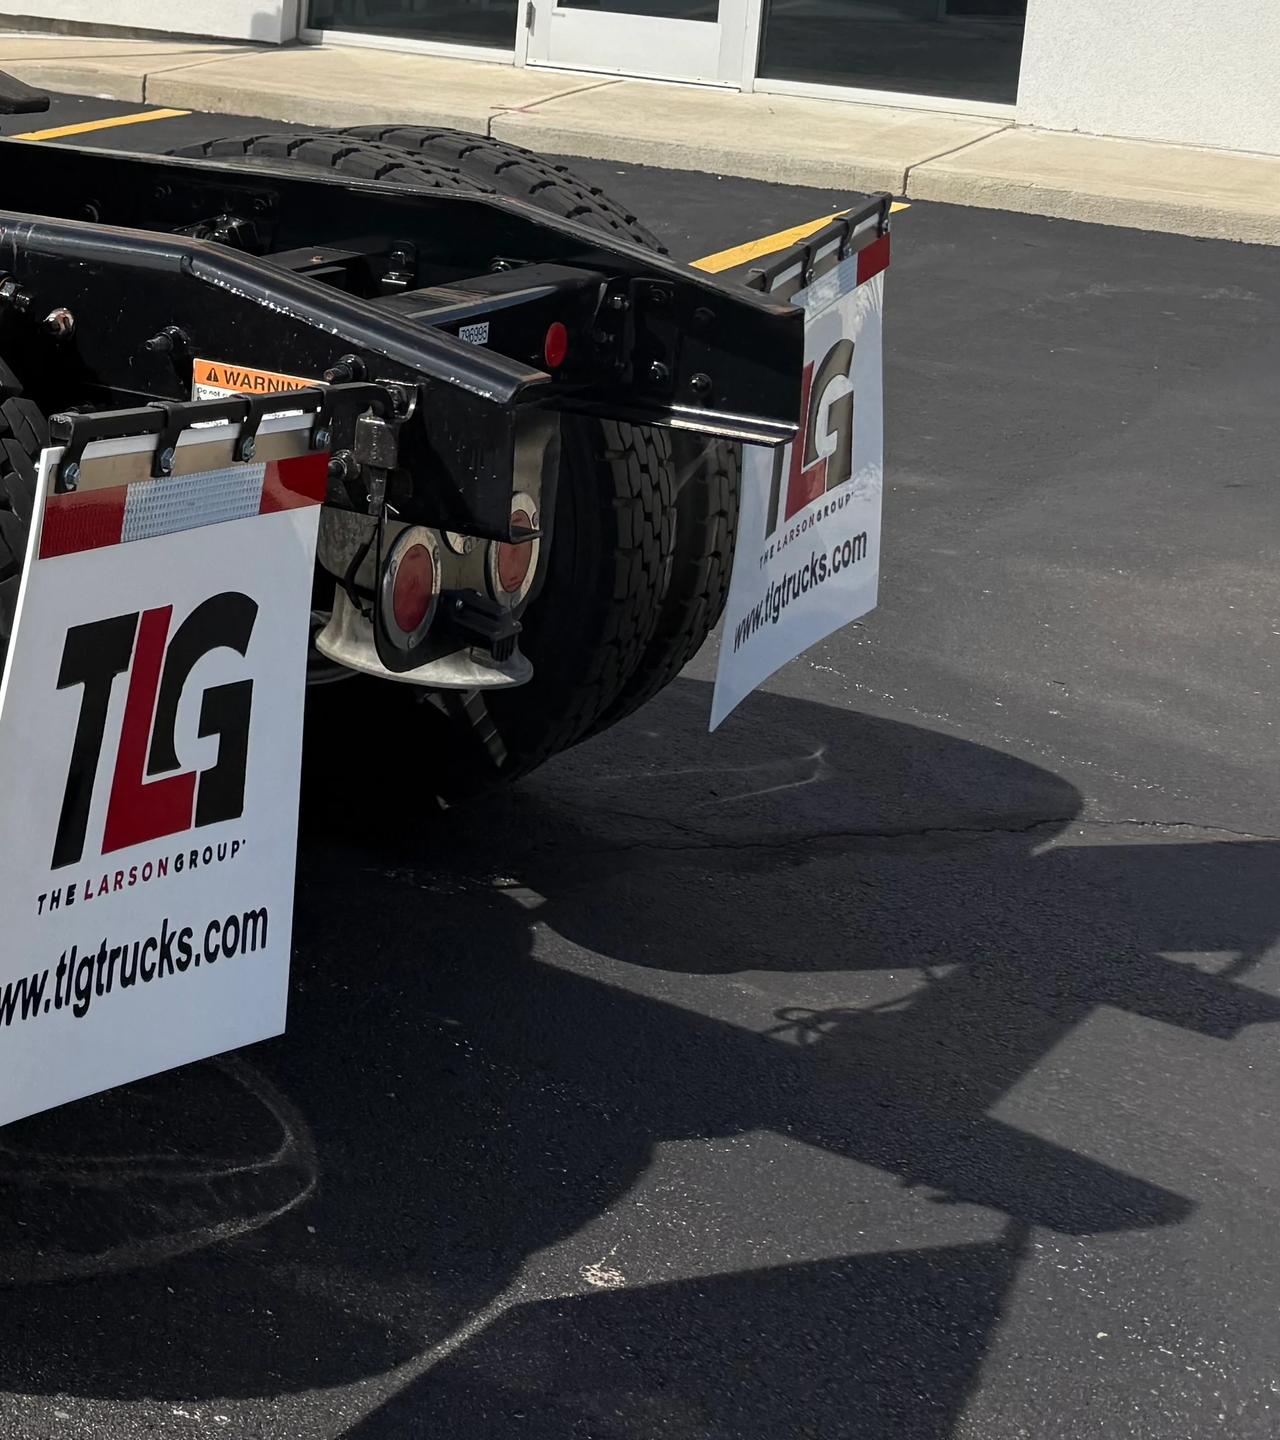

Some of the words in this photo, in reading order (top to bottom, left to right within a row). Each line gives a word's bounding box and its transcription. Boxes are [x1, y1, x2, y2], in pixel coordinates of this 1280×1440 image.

[197, 387, 207, 395] Do
[224, 370, 306, 393] WARNIN
[759, 544, 774, 570] THE
[733, 531, 868, 654] www.tlgtrucks.com
[50, 591, 259, 870] TLG
[37, 883, 77, 916] THE
